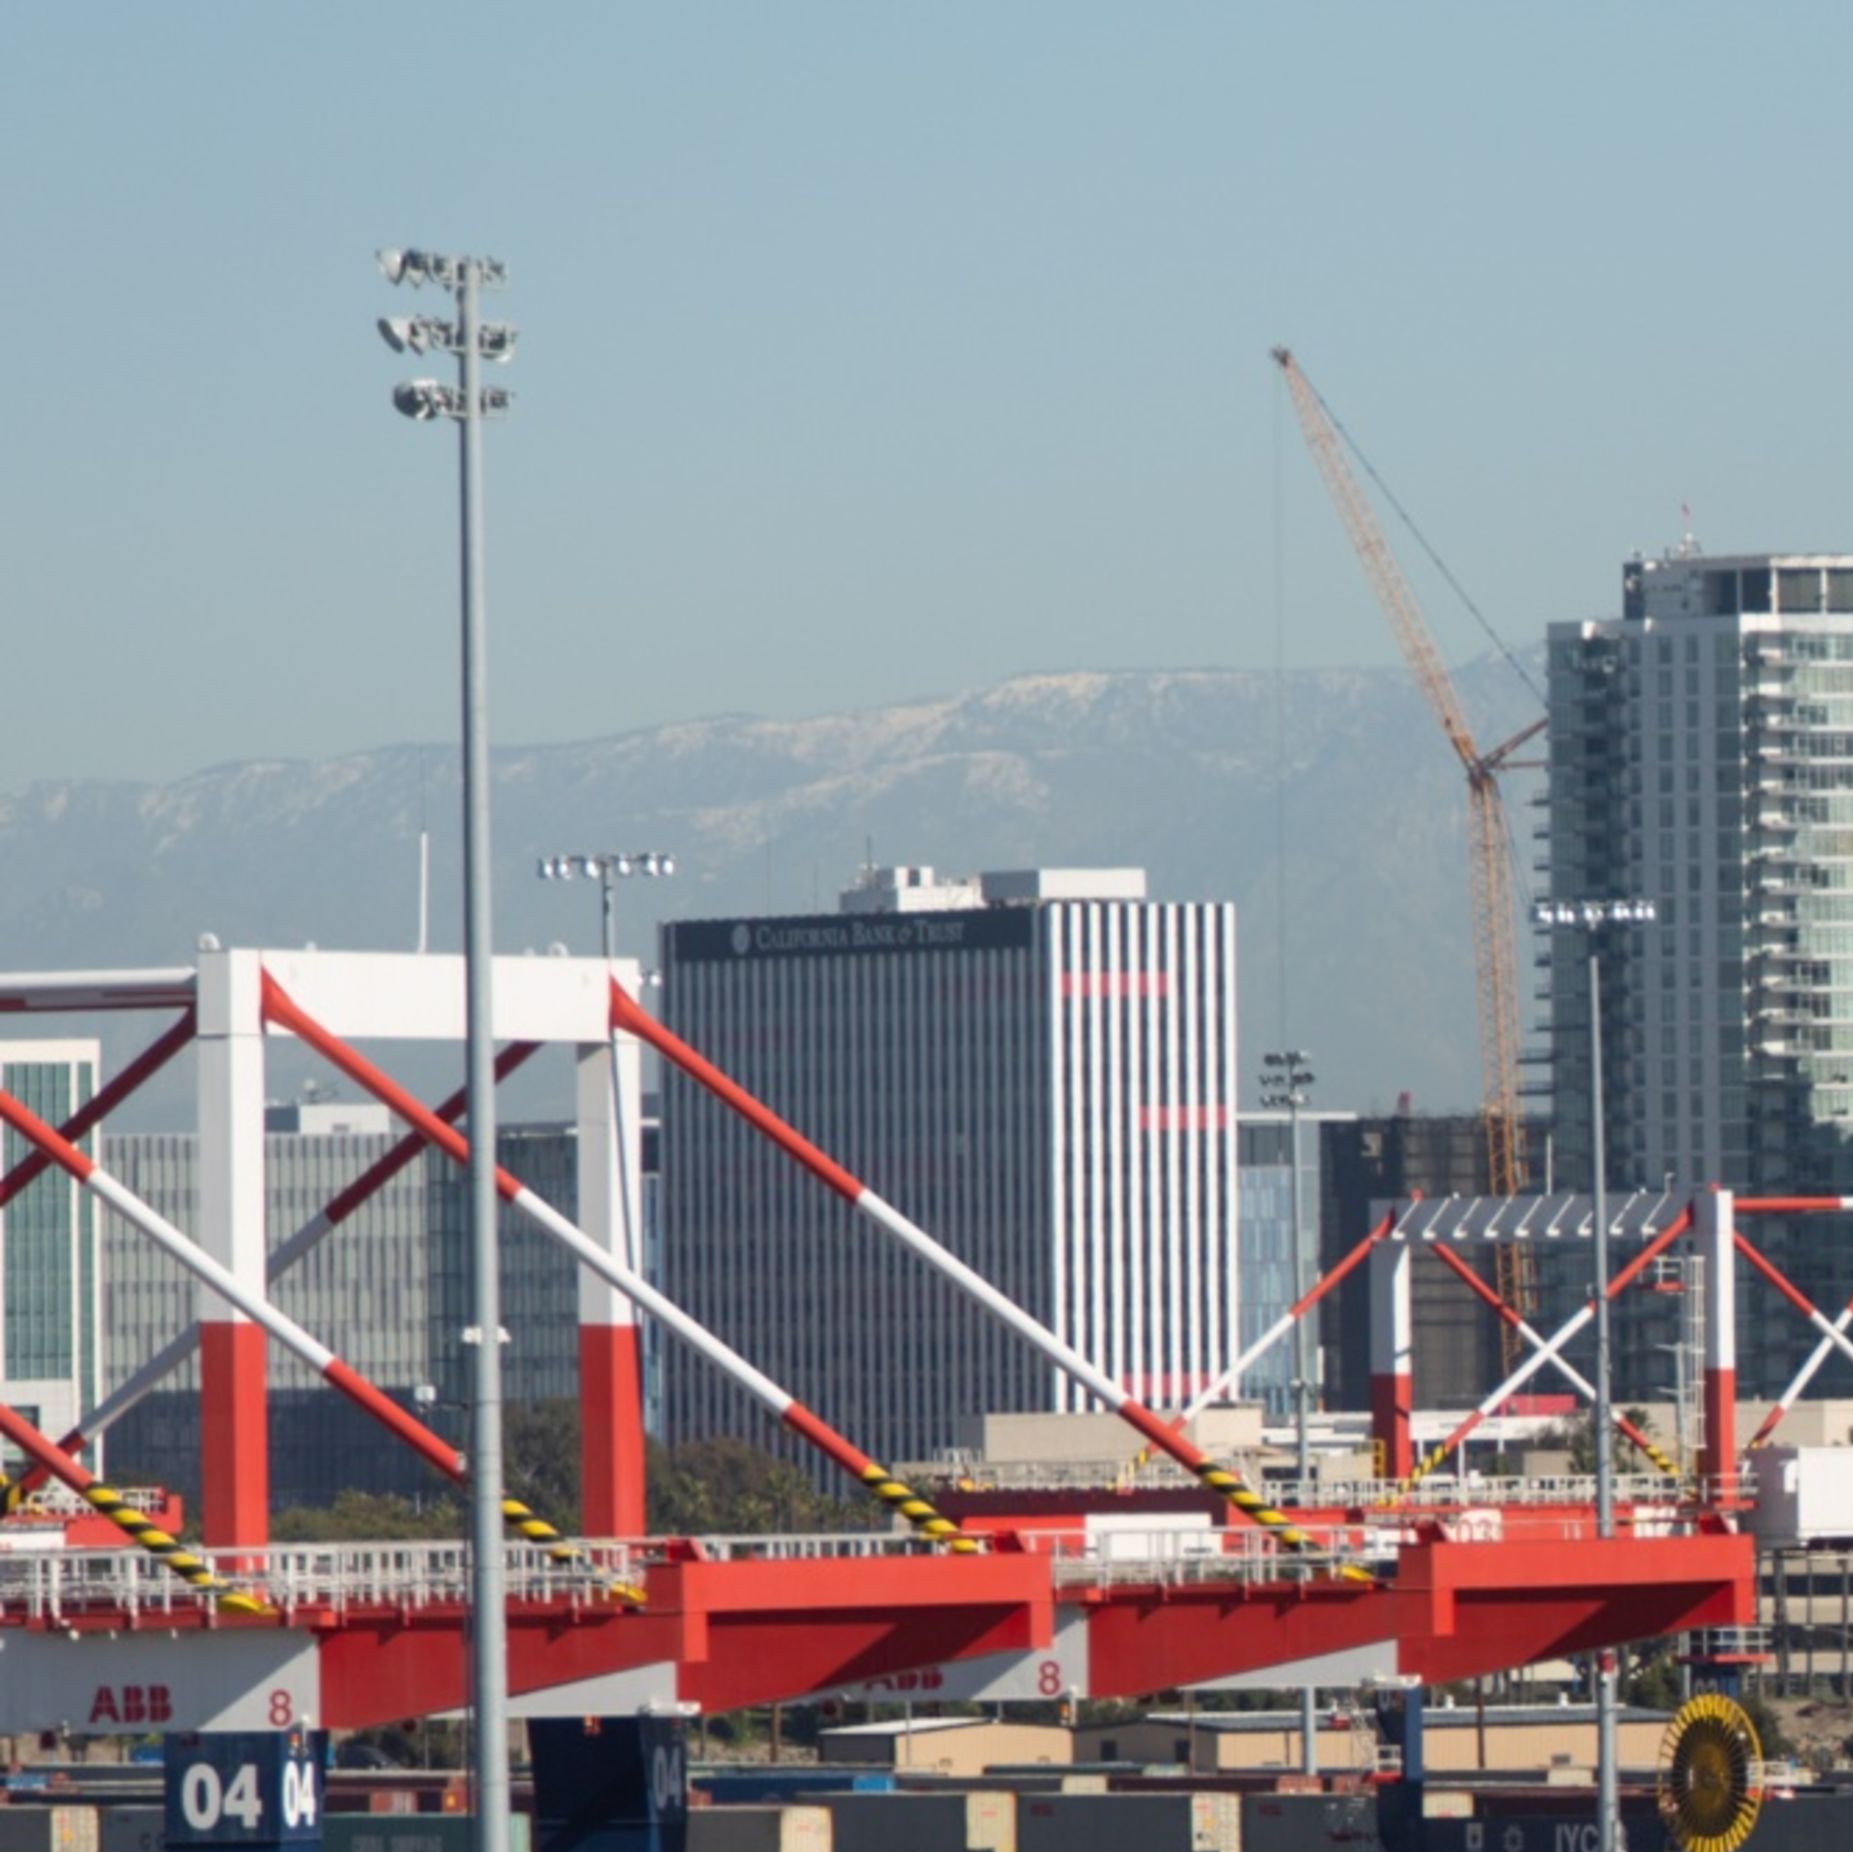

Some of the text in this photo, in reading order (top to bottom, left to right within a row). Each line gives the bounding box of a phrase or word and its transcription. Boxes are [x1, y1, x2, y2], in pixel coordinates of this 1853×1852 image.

[755, 926, 848, 949] CALIFORNIA
[852, 921, 895, 946] BANK
[914, 918, 964, 943] TRUST
[1038, 1660, 1061, 1696] 8
[89, 1685, 173, 1724] ABB
[268, 1688, 292, 1727] 8
[181, 1761, 263, 1831] 04
[282, 1760, 317, 1828] 04
[652, 1746, 682, 1809] 04
